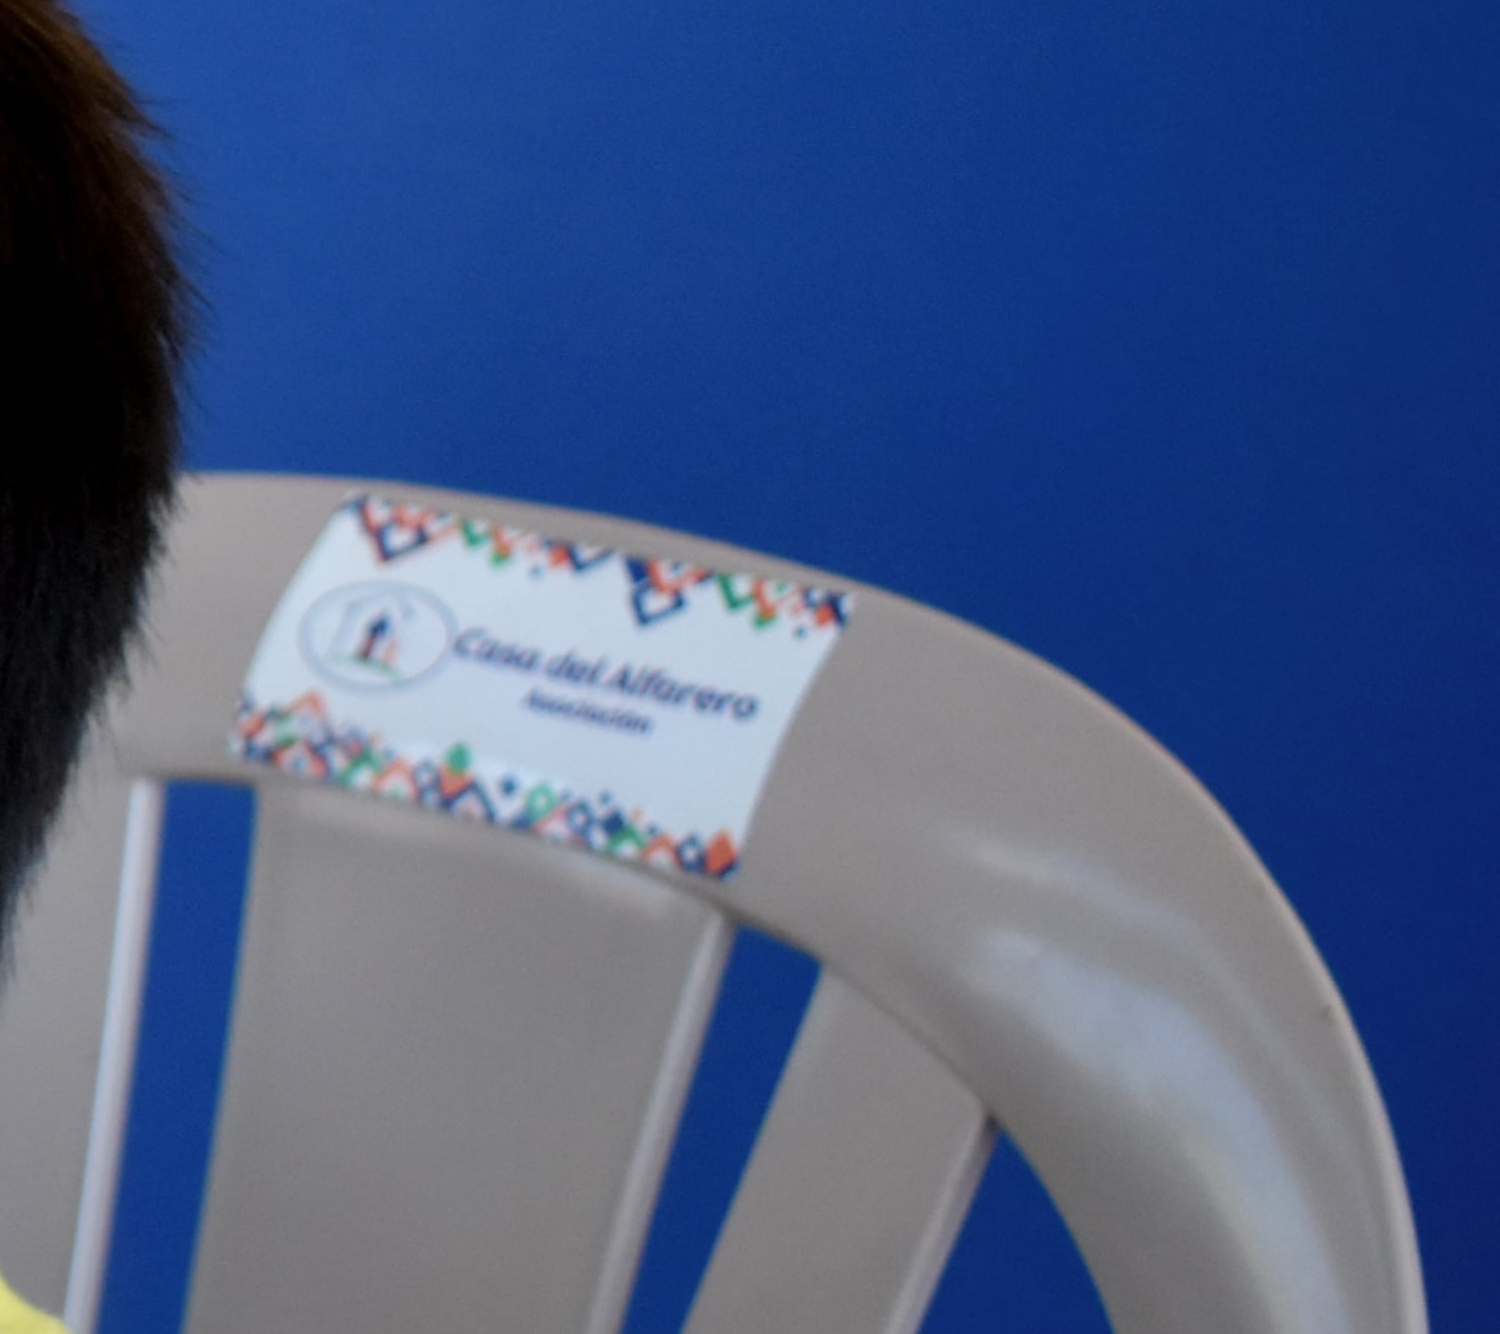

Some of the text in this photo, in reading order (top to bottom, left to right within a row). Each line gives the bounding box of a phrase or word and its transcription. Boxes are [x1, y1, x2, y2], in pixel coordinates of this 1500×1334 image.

[454, 627, 758, 719] Casa del Alfarero
